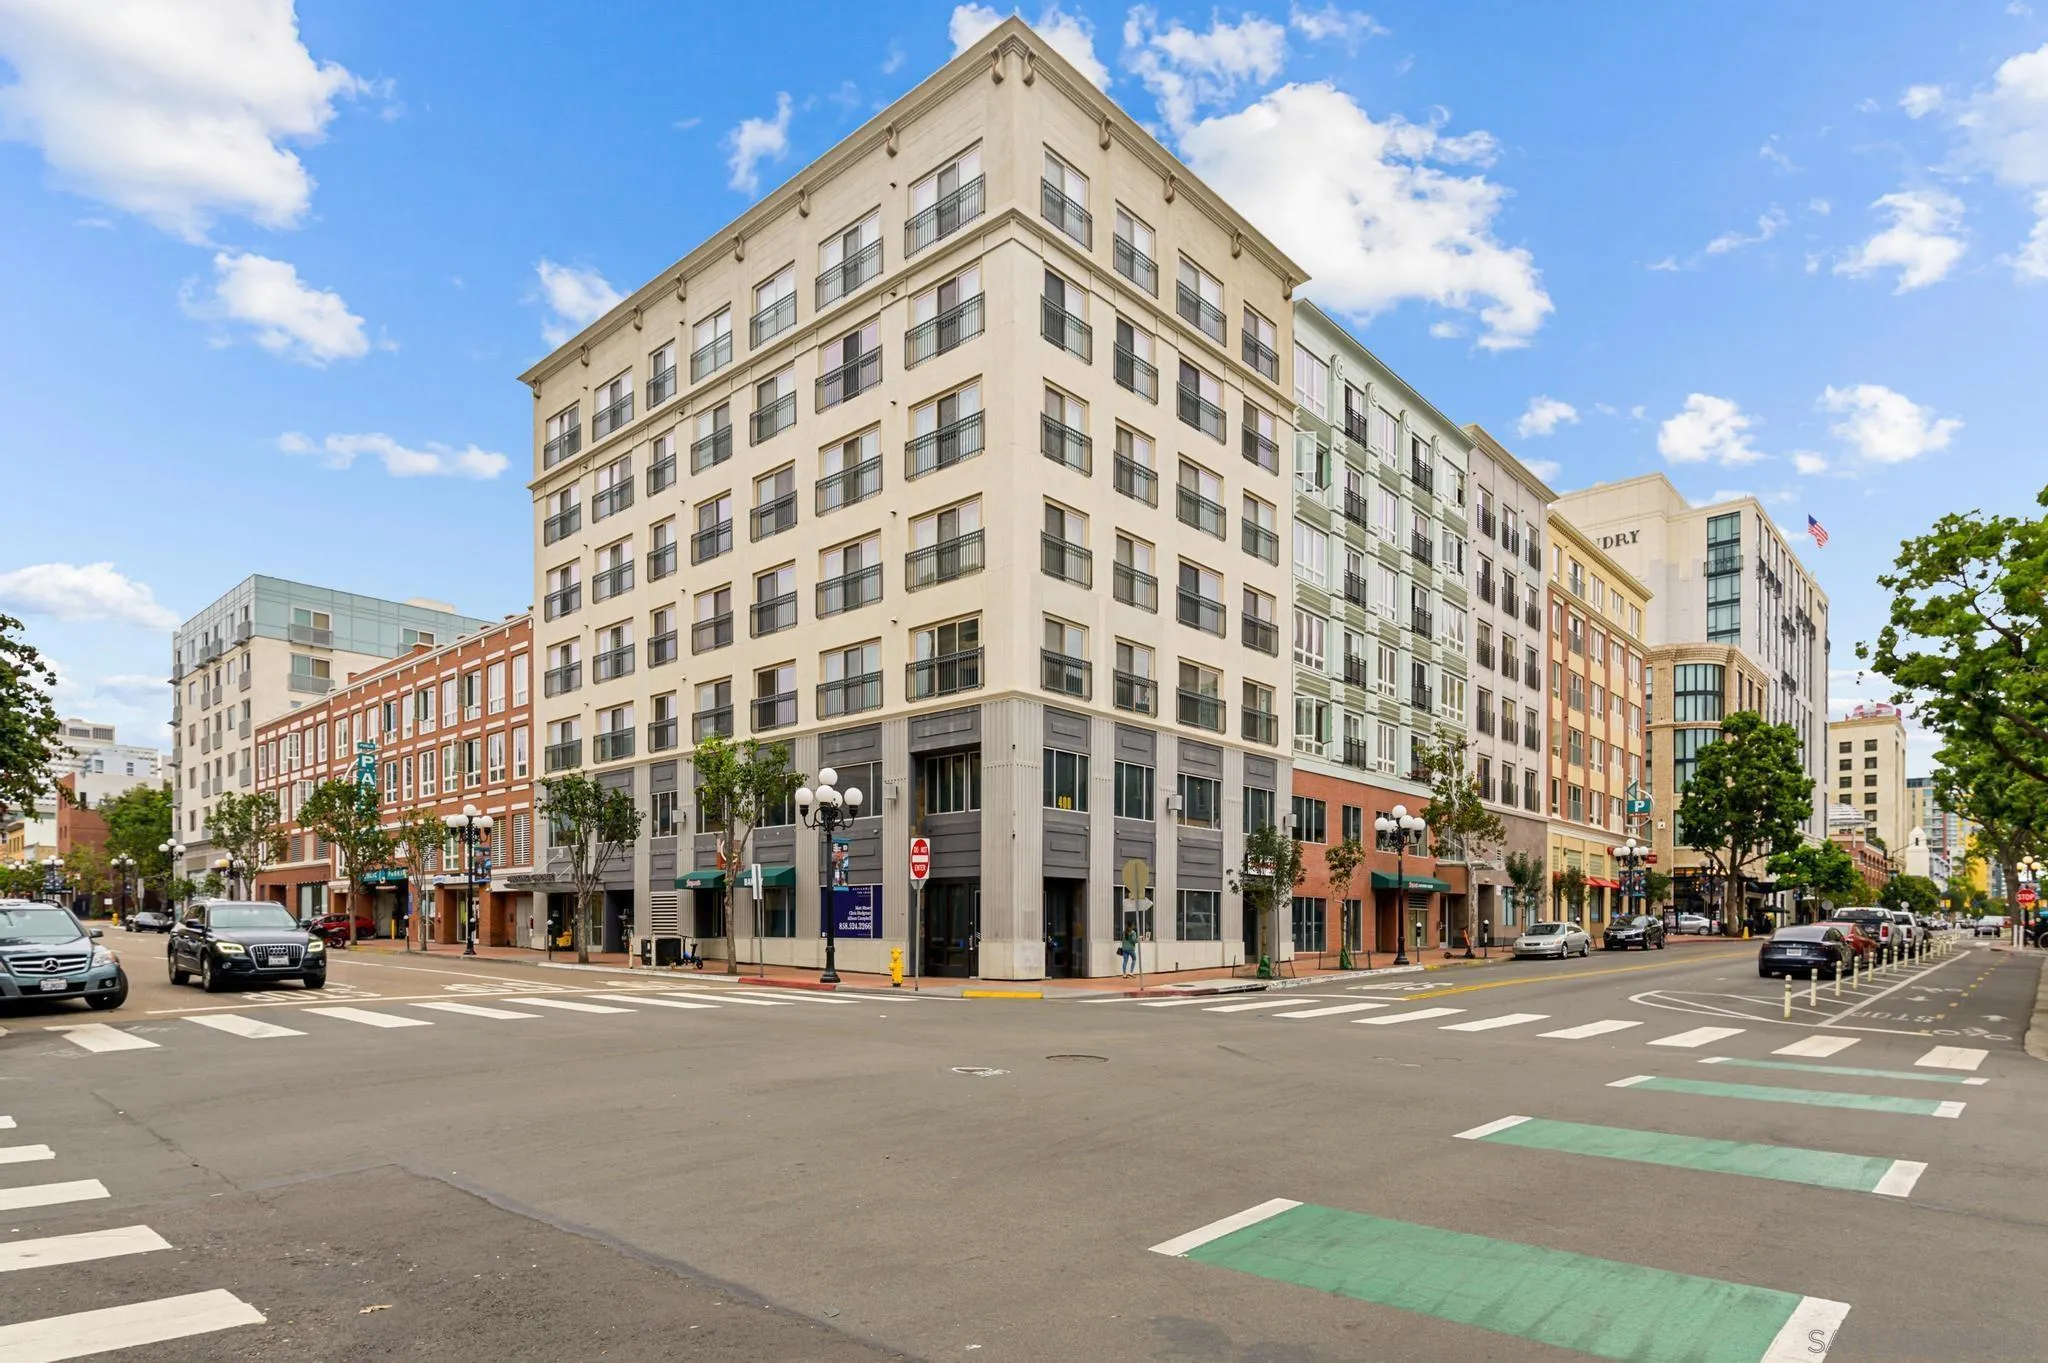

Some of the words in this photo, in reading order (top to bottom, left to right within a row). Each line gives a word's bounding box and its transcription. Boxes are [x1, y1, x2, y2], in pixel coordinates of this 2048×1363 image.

[1634, 800, 1645, 812] P
[2017, 893, 2035, 901] STOP
[1850, 1010, 1936, 1023] STOP
